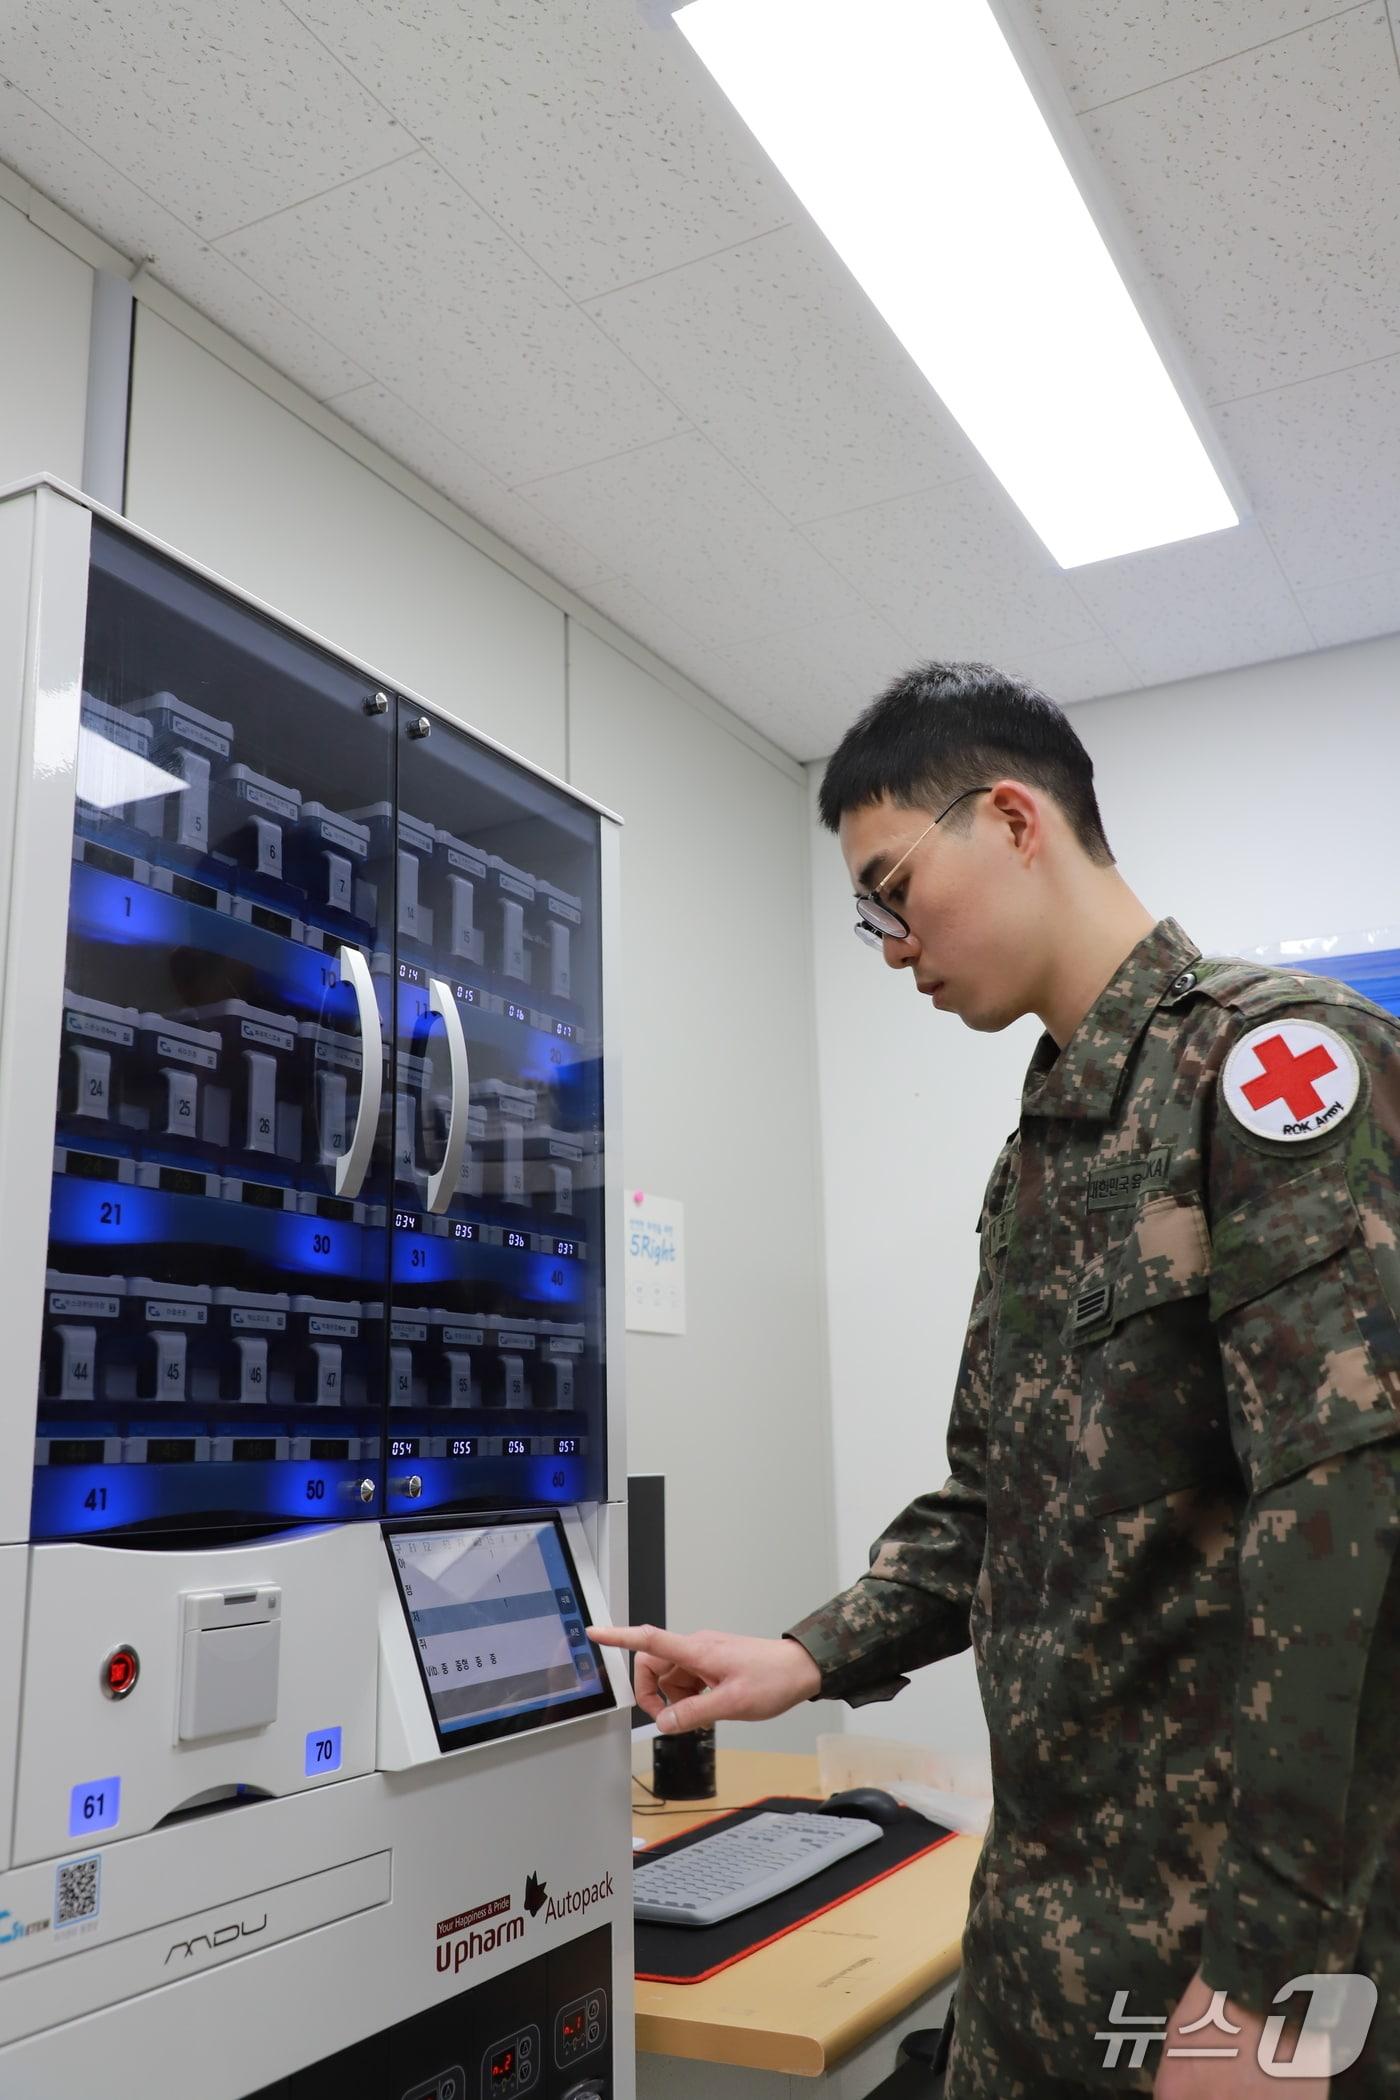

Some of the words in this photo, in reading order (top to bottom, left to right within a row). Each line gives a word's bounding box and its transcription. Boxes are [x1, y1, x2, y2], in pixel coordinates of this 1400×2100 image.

[269, 843, 277, 860] 6
[338, 879, 346, 893] 7
[124, 896, 131, 918] 1
[320, 967, 336, 988] 10
[399, 964, 418, 981] 014
[456, 986, 474, 1002] 015
[415, 1000, 429, 1019] 11
[556, 1022, 572, 1037] 017
[89, 1078, 103, 1096] 24
[177, 1100, 191, 1117] 25
[259, 1117, 271, 1134] 26
[1283, 1120, 1312, 1135] ROK
[1315, 1100, 1344, 1127] Army
[332, 1134, 342, 1148] 27
[100, 1202, 122, 1225] 21
[395, 1213, 416, 1229] 034
[455, 1224, 473, 1239] 035
[313, 1234, 331, 1255] 30
[557, 1242, 574, 1255] 037
[411, 1249, 426, 1267] 31
[551, 1269, 564, 1286] 40
[73, 1362, 89, 1380] 44
[166, 1362, 180, 1380] 45
[250, 1367, 262, 1383] 46
[326, 1372, 336, 1388] 47
[392, 1441, 412, 1456] 054
[453, 1441, 472, 1454] 055
[559, 1440, 575, 1453] 057
[552, 1471, 565, 1488] 60
[305, 1479, 325, 1500] 50
[84, 1488, 107, 1511] 41
[315, 1739, 333, 1762] 70
[83, 1793, 105, 1819] 61
[545, 1871, 614, 1925] Autopack
[438, 1920, 454, 1935] Your
[455, 1907, 487, 1928] Happiness
[494, 1898, 510, 1912] Pride
[436, 1916, 525, 1974] Upharm
